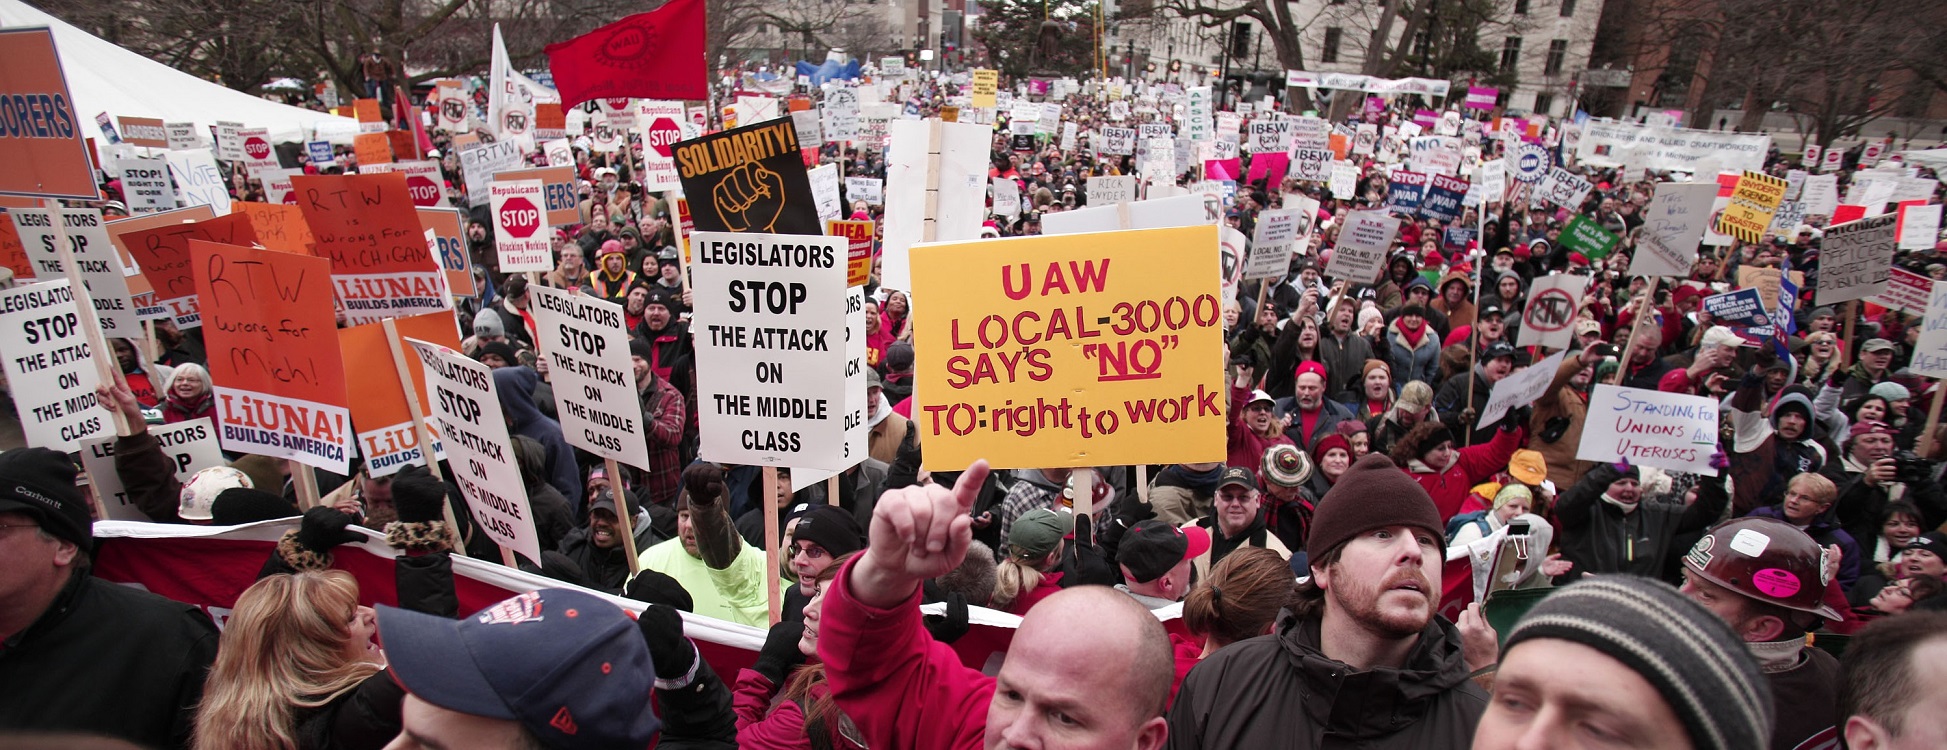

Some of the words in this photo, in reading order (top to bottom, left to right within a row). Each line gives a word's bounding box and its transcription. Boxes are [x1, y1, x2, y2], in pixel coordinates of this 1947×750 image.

[641, 105, 682, 116] Republicans
[1190, 92, 1203, 140] AFSCME
[121, 124, 166, 141] LABORERS
[650, 129, 680, 147] STOP
[1102, 127, 1134, 139] IBEW
[1141, 126, 1170, 135] IBEW
[1251, 122, 1289, 135] IBEW
[246, 144, 268, 154] STOP
[476, 140, 515, 163] RTW
[677, 123, 797, 179] SOLIDARITY!
[1590, 129, 1637, 143] BRICKLAYERS
[1640, 136, 1656, 144] AND
[1659, 138, 1687, 147] ALLIED
[1690, 141, 1759, 152] CRAFTWORKERS
[1294, 149, 1333, 162] IBEW
[1521, 158, 1539, 168] UAW
[125, 169, 162, 179] STOP!
[1098, 179, 1124, 189] RICK
[1392, 171, 1427, 185] STOP
[1434, 176, 1469, 192] STOP
[1551, 168, 1591, 193] IBEW
[187, 186, 230, 210] NO
[492, 186, 539, 196] Republicans
[1090, 190, 1127, 200] SNYDER
[1393, 190, 1418, 202] WAR
[1738, 188, 1774, 205] AGENDA
[1740, 179, 1782, 196] SNYDER'S
[1432, 194, 1457, 209] WAR
[16, 213, 98, 227] LEGISTORS
[501, 209, 538, 227] STOP
[1421, 209, 1454, 222] WORKERS
[1724, 215, 1764, 233] DISASTER
[1742, 210, 1755, 220] TO
[833, 222, 866, 240] UEA
[1579, 220, 1594, 234] Let's
[1596, 231, 1611, 244] Pull
[1823, 216, 1897, 239] MICHIGAN
[499, 242, 524, 254] Attacking
[525, 241, 548, 252] Working
[1253, 246, 1274, 255] LOCAL
[1573, 229, 1605, 251] Together
[507, 255, 543, 264] Americans
[700, 241, 835, 268] LEGISLATORS
[1335, 260, 1373, 270] BROTHERHOOD
[1336, 246, 1358, 258] LOCAL
[1359, 251, 1371, 260] NO.
[1374, 253, 1382, 261] 17
[1337, 255, 1375, 265] INTERNATIONAL
[1822, 242, 1892, 266] OFFICERS
[38, 260, 64, 273] THE
[1820, 260, 1867, 276] PROTECT
[337, 276, 440, 299] LiUNA!
[1002, 258, 1111, 301] UAW
[346, 299, 389, 310] BUILDS
[391, 298, 445, 309] AMERICA
[728, 279, 808, 315] STOP
[1706, 296, 1725, 305] FIGHT
[1709, 301, 1737, 312] ATTACK
[536, 291, 620, 329] LEGISLATORS
[1714, 304, 1758, 317] AMERICAN
[1723, 312, 1753, 321] DREAM
[23, 312, 78, 345] STOP
[215, 316, 274, 342] wrong
[278, 319, 310, 339] for
[951, 294, 1220, 350] LOCAL-3000
[559, 323, 606, 357] STOP
[708, 325, 747, 349] THE
[752, 327, 829, 352] ATTACK
[15, 356, 48, 374] THE
[51, 343, 91, 367] ATTAC
[230, 347, 319, 386] Mich!
[418, 346, 490, 393] LEGISLATORS
[552, 351, 576, 373] THE
[578, 361, 627, 388] ATTACK
[946, 346, 1053, 389] SAY'S
[58, 371, 80, 390] ON
[755, 361, 783, 384] ON
[436, 384, 482, 426] STOP
[584, 384, 603, 403] ON
[32, 404, 63, 423] THE
[66, 391, 100, 415] MIDD
[563, 399, 588, 421] THE
[588, 409, 635, 435] MIDDLE
[713, 393, 751, 416] THE
[757, 396, 828, 420] MIDDLE
[1078, 407, 1119, 438] to
[1124, 384, 1221, 424] work
[1612, 390, 1695, 418] STANDING
[1698, 406, 1715, 423] FOR
[61, 416, 102, 442] CLASS
[220, 394, 344, 445] LiUNA!
[1615, 415, 1685, 438] UNIONS
[1692, 428, 1715, 444] AND
[224, 425, 281, 447] BUILDS
[283, 434, 345, 462] AMERICA
[437, 416, 459, 444] THE
[460, 429, 507, 464] ATTACK
[584, 428, 622, 452] CLASS
[741, 429, 801, 453] CLASS
[1616, 437, 1697, 462] UTERUSES
[371, 448, 420, 470] BUILDS
[469, 458, 488, 482] ON
[15, 485, 62, 510] Carhartt
[457, 473, 479, 500] THE
[477, 487, 523, 521] MIDDLE
[478, 509, 516, 540] CLASS
